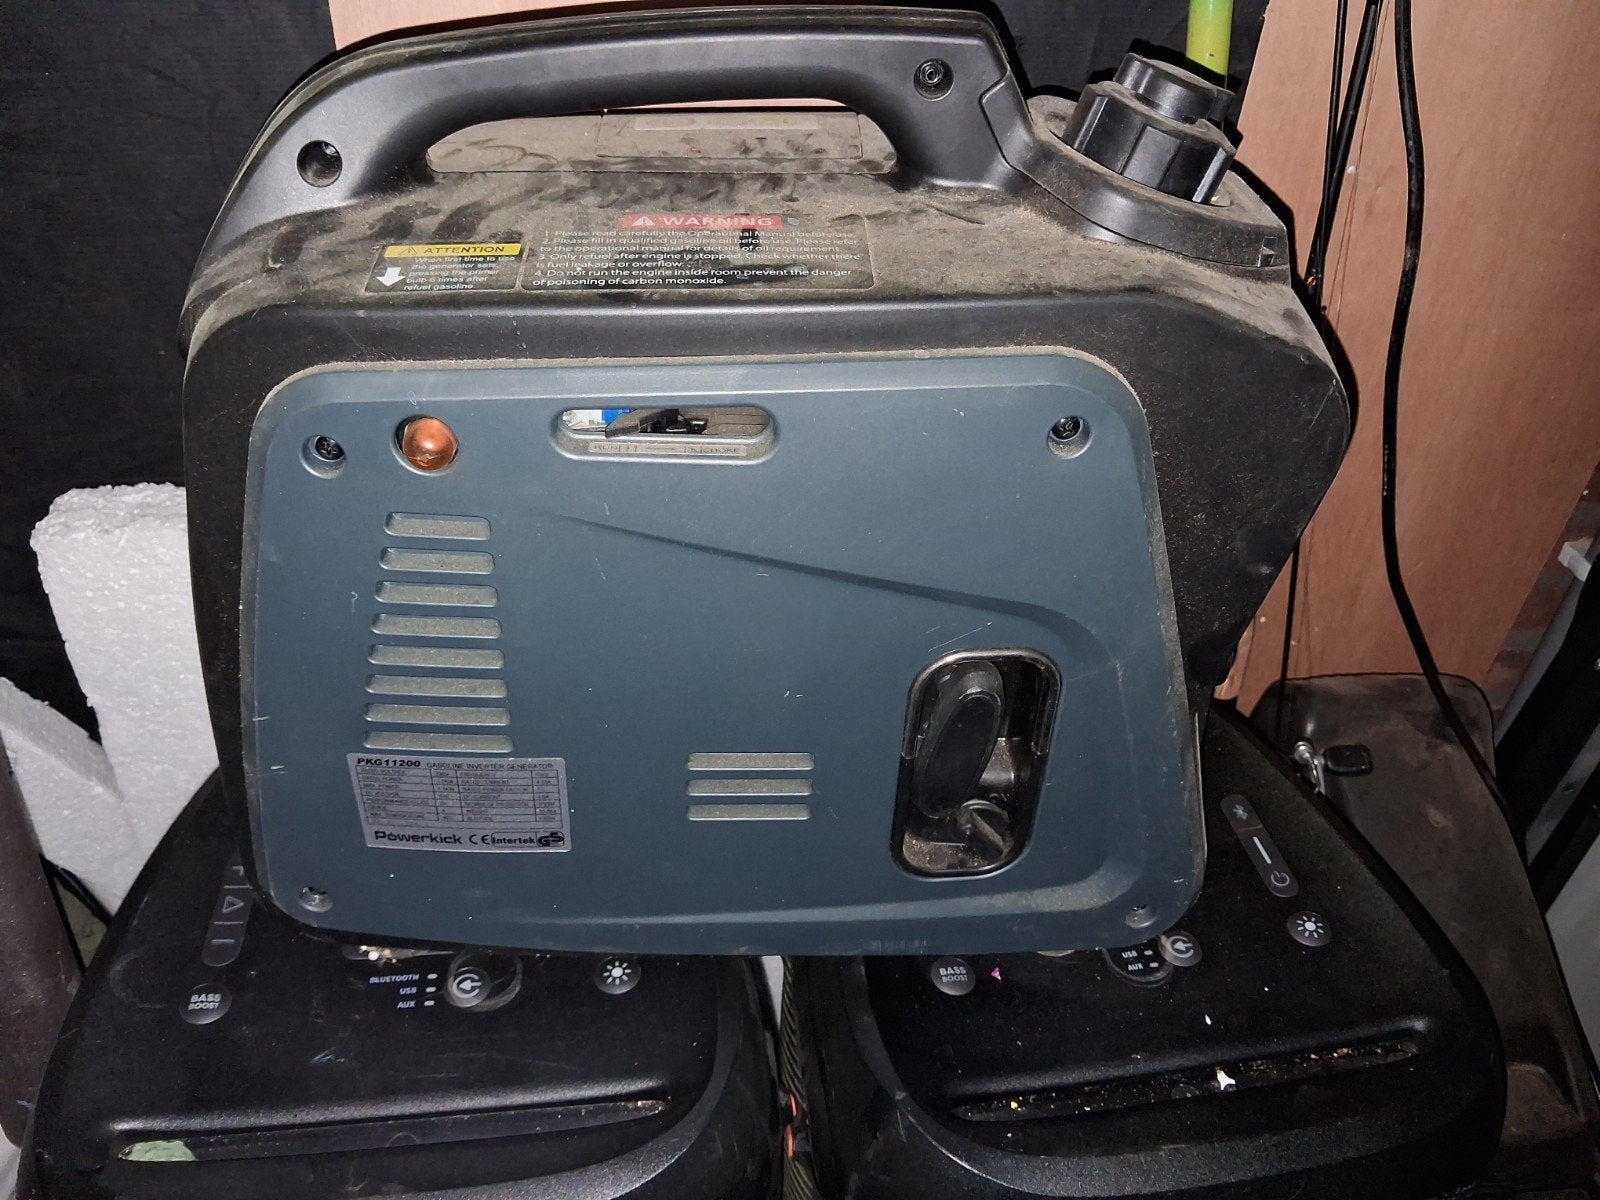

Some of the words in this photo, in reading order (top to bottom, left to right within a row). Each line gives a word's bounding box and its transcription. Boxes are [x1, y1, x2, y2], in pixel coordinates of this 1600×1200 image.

[661, 217, 773, 226] WARNING
[619, 230, 665, 238] carefully
[620, 238, 667, 246] qualified
[669, 238, 718, 246] gasoline
[423, 245, 505, 255] ATTENTION
[550, 253, 577, 261] Only
[613, 252, 641, 260] after
[641, 253, 684, 261] engine
[745, 252, 780, 260] Check
[830, 253, 861, 261] there
[411, 262, 427, 270] the
[428, 262, 474, 271] generator
[571, 261, 616, 269] leakage
[631, 260, 685, 268] overflow.
[468, 269, 500, 277] primer
[547, 269, 565, 277] Do
[566, 269, 586, 277] not
[674, 268, 709, 276] inside
[811, 268, 852, 276] danger
[406, 276, 428, 284] bulb
[546, 279, 606, 287] poisoning
[607, 278, 621, 286] of
[403, 283, 431, 291] refuel
[433, 283, 475, 291] gasoline.
[357, 757, 421, 768] PKG11200
[374, 831, 463, 844] Powerkick
[538, 832, 565, 847] GS
[1121, 950, 1138, 959] USB
[939, 966, 967, 975] BASS
[1127, 963, 1144, 971] AUX
[369, 974, 420, 984] BLUETOOTH
[942, 974, 968, 982] BOOST
[400, 987, 417, 995] USB
[190, 993, 221, 1003] BASS
[188, 1002, 220, 1010] BOOST
[397, 1000, 416, 1009] AUX
